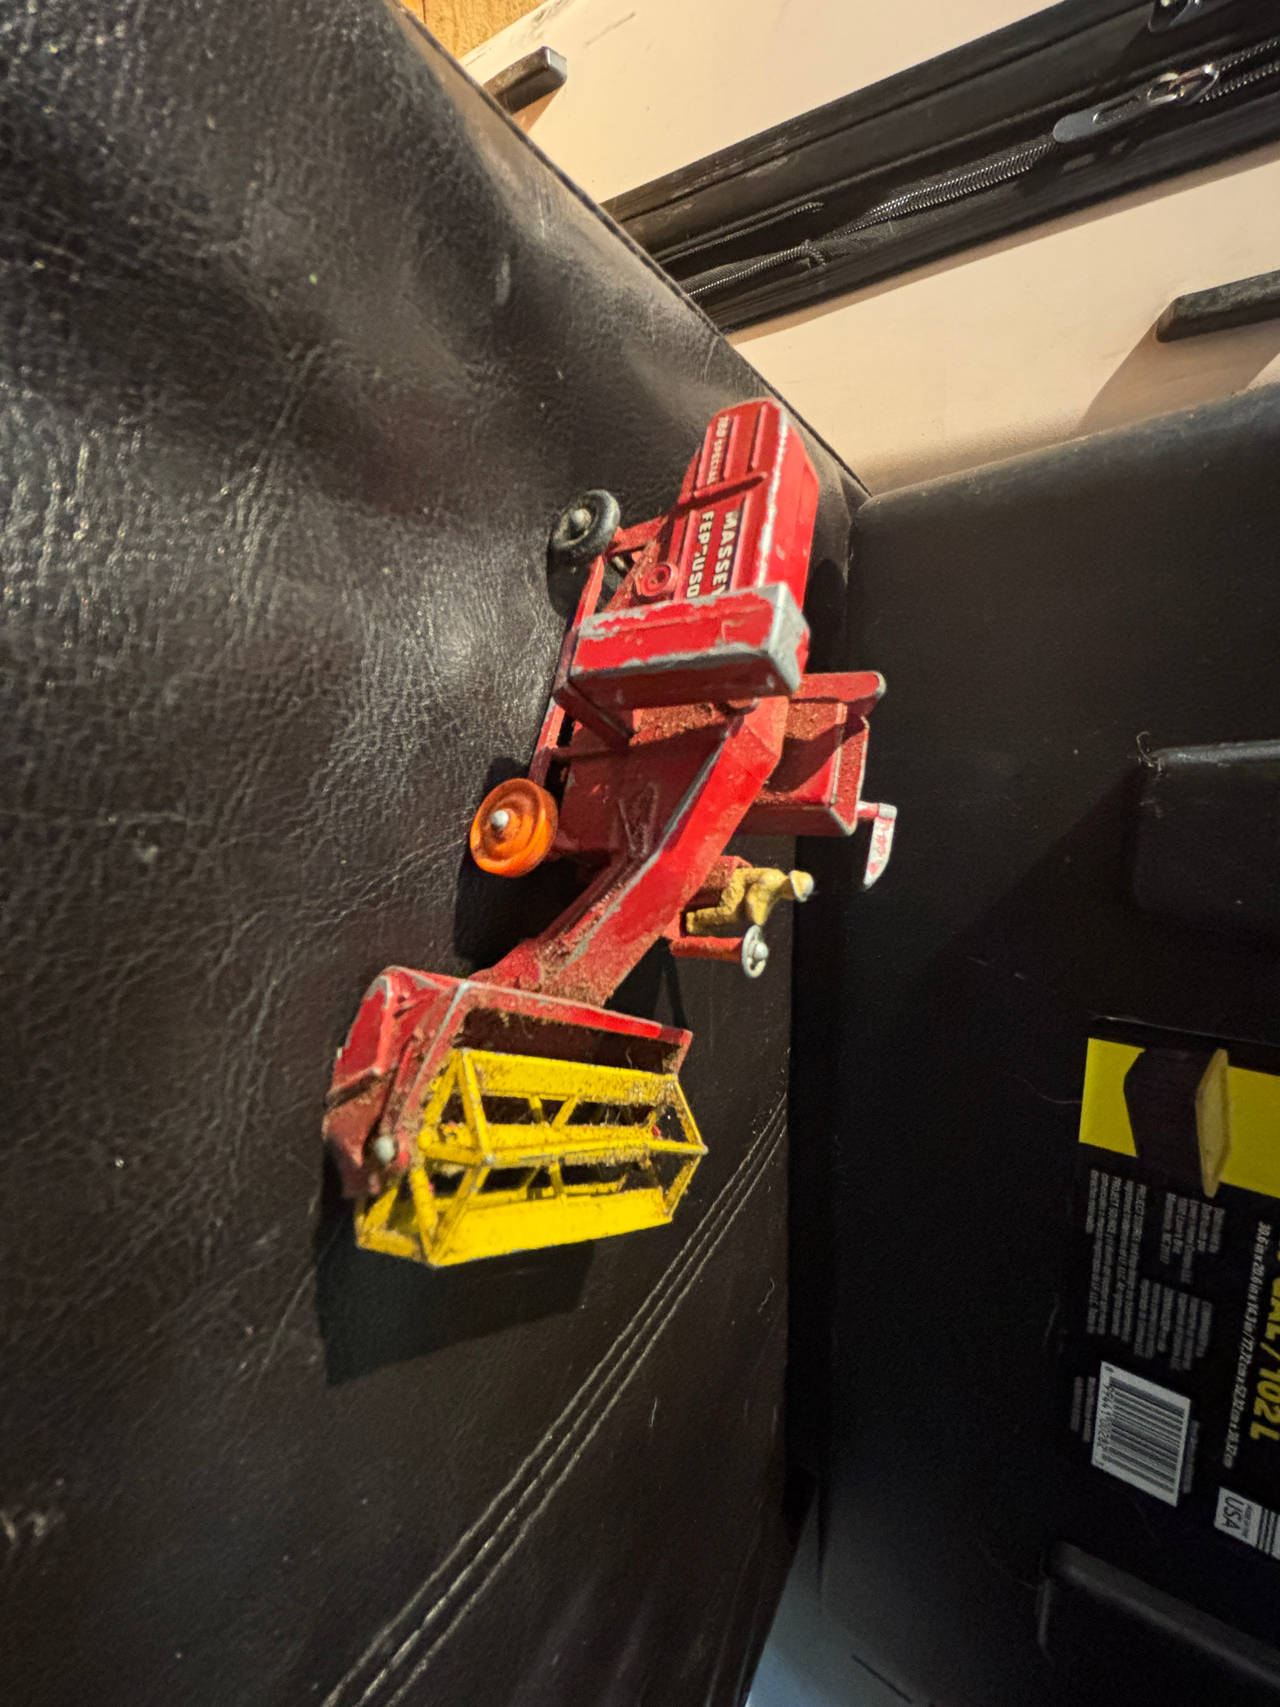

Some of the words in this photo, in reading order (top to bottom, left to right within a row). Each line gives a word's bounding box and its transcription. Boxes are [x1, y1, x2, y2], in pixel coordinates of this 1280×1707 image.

[711, 511, 739, 597] MASSEY
[1253, 1367, 1280, 1424] 102
[1249, 1421, 1280, 1441] L
[1221, 1496, 1246, 1530] USA
